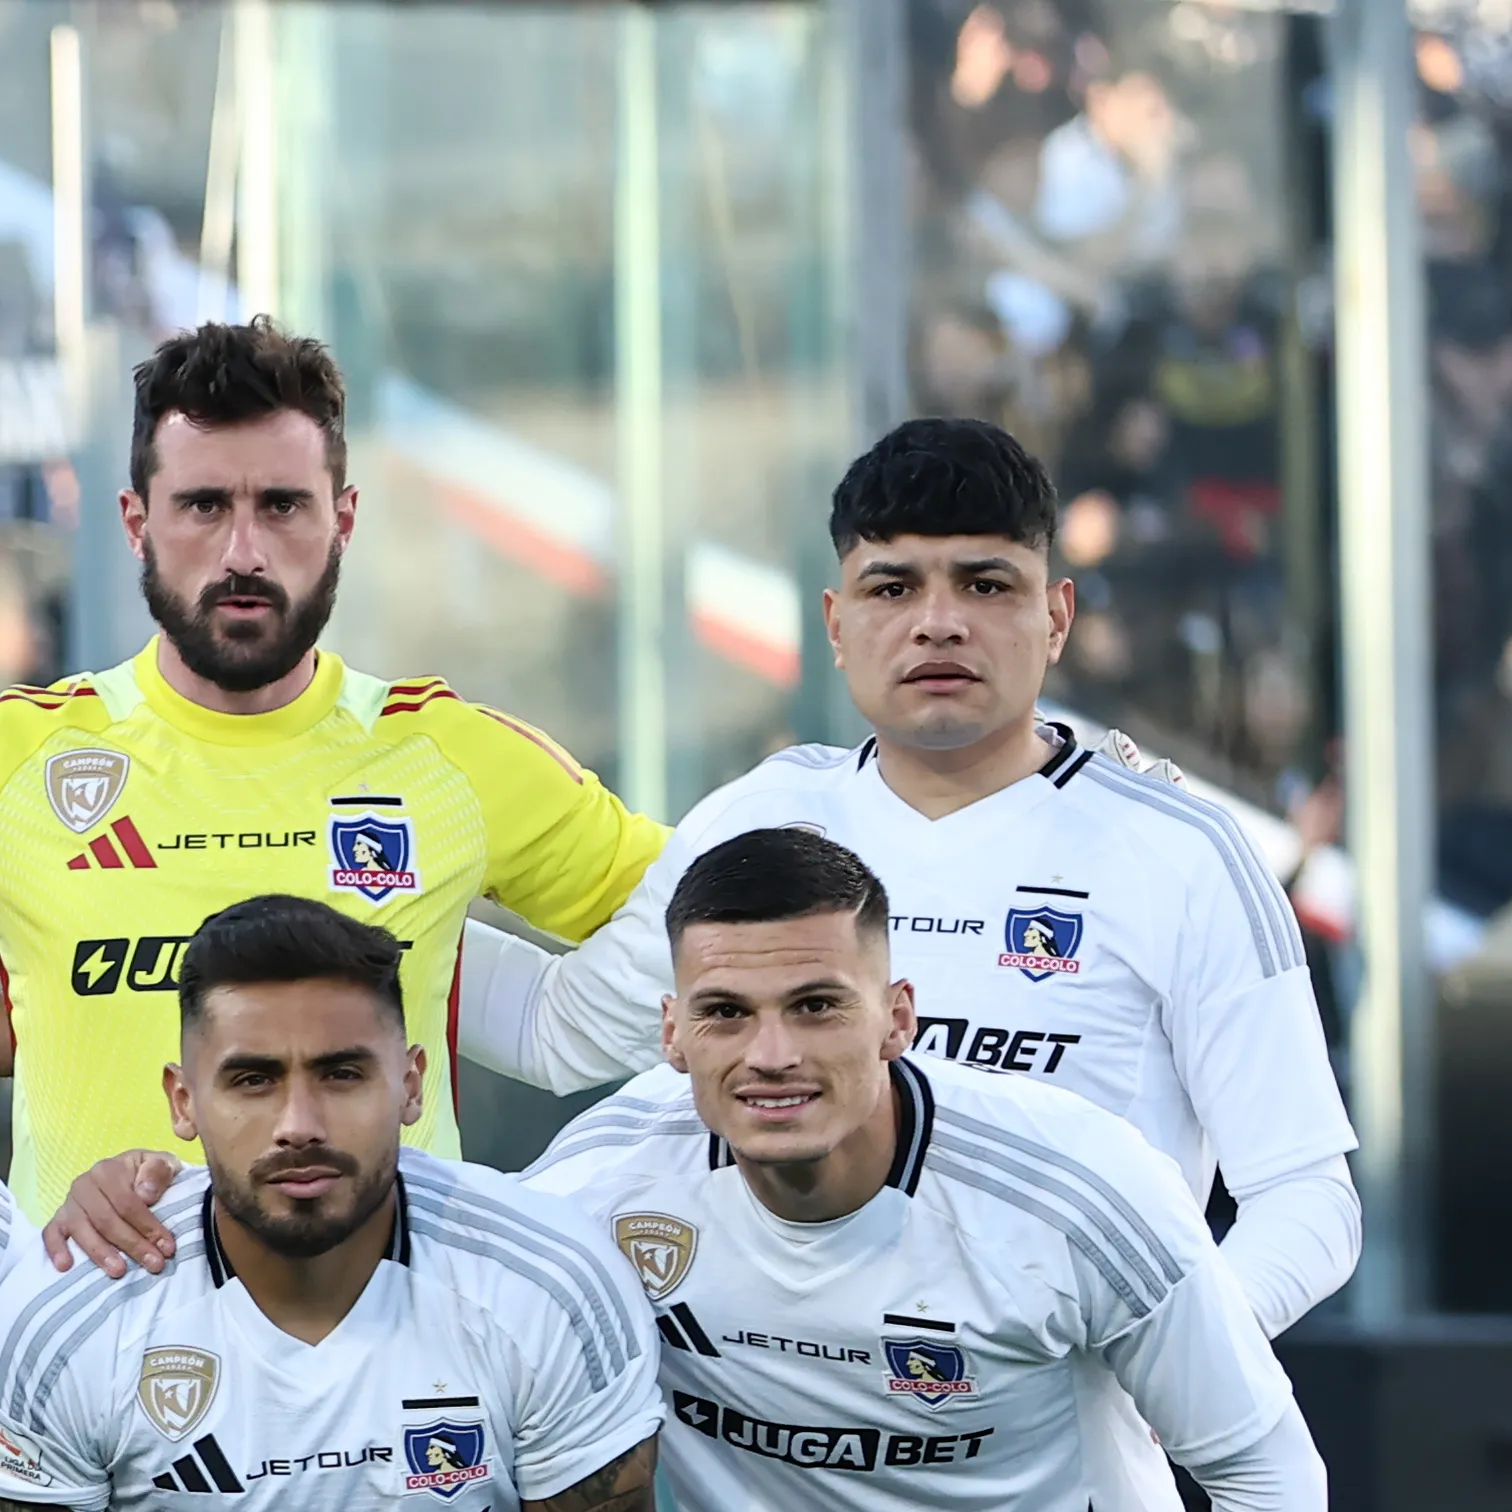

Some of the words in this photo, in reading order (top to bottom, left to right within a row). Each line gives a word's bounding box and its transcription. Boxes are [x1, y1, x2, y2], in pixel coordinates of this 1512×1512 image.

[63, 756, 115, 770] CAMPEÓN
[157, 831, 317, 850] JETOUR
[336, 870, 412, 887] COLO-COLO
[889, 916, 985, 935] TOUR
[1000, 954, 1078, 973] COLO-COLO
[628, 1220, 682, 1236] CAMPEÓN
[722, 1330, 872, 1365] JETOUR
[150, 1353, 205, 1368] CAMPEÓN
[892, 1379, 972, 1393] COLO-COLO
[0, 1461, 42, 1481] PRIMERA
[4, 1455, 26, 1468] LIGA
[246, 1446, 393, 1480] JETOUR
[408, 1465, 486, 1489] COLO-COLO
